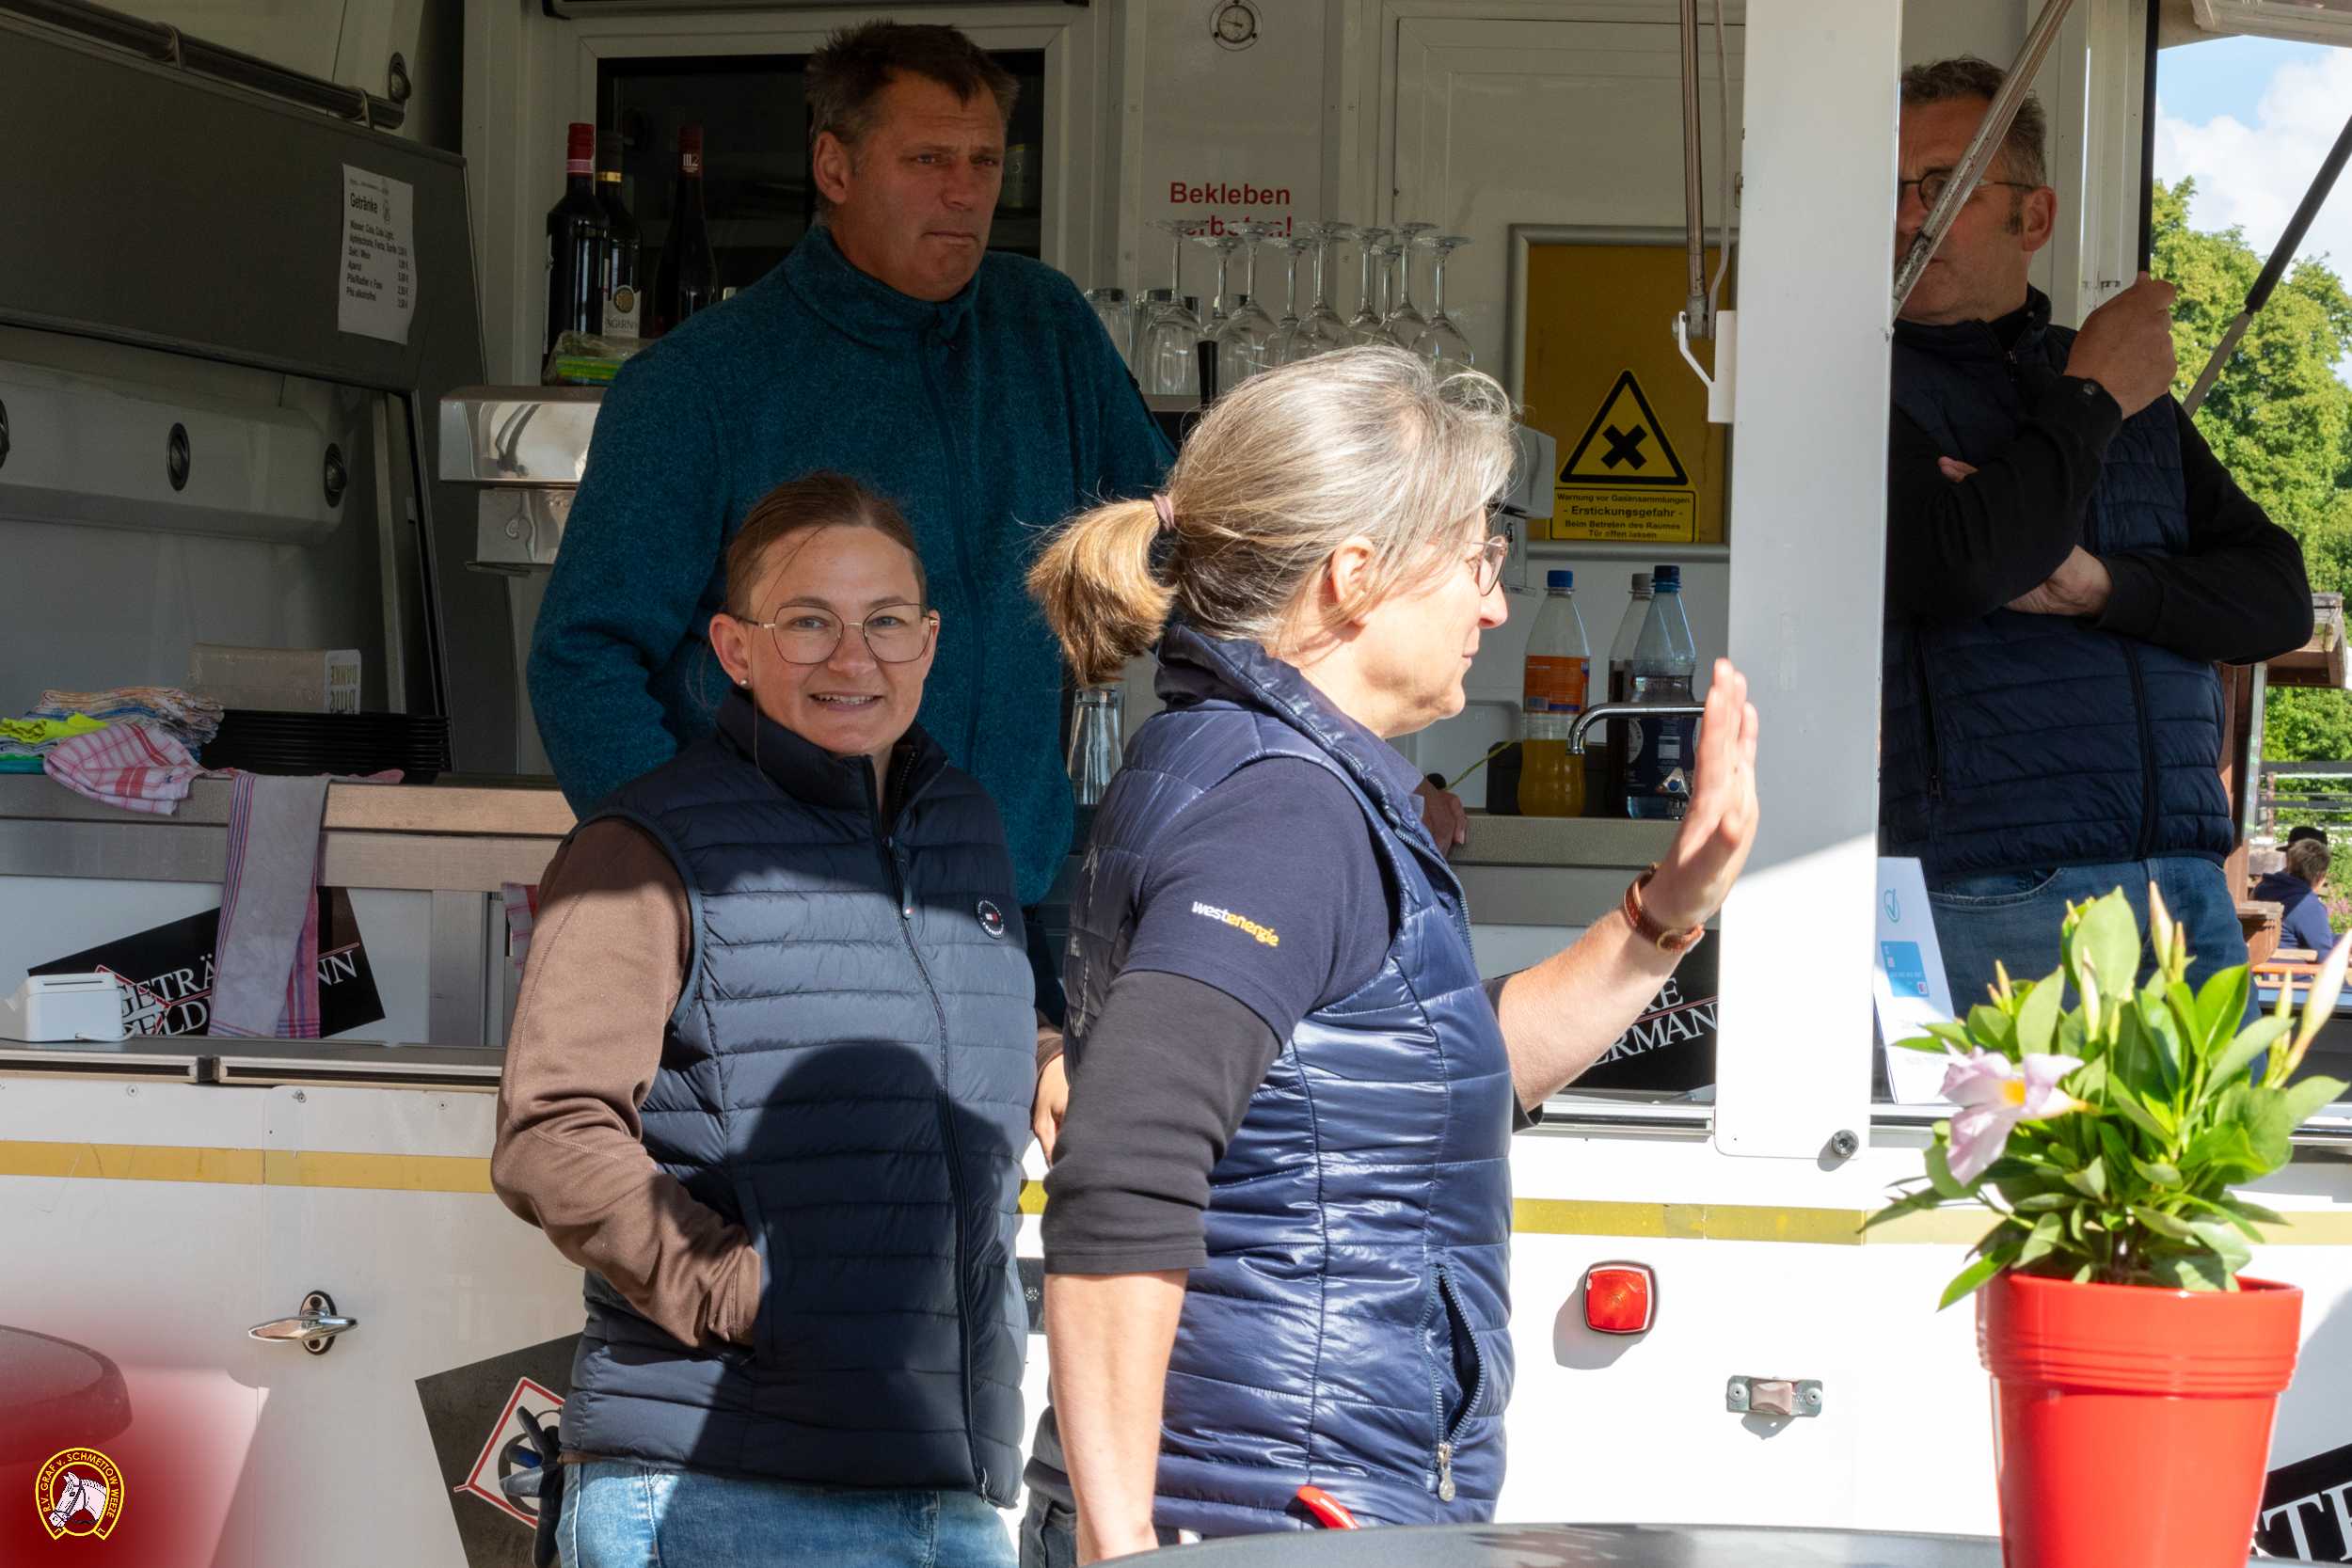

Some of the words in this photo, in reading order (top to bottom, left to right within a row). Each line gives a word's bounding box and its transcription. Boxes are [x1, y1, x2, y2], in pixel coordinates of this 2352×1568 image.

[1170, 182, 1291, 205] Bekleben
[350, 193, 378, 214] Getränke
[1557, 494, 1594, 503] Warnung
[1571, 506, 1677, 518] Erstickungsgefahr
[1565, 519, 1587, 529] Beim
[1589, 521, 1626, 530] Betreten
[1628, 521, 1644, 530] des
[1645, 522, 1680, 531] Raumes
[1191, 901, 1279, 947] westenergie
